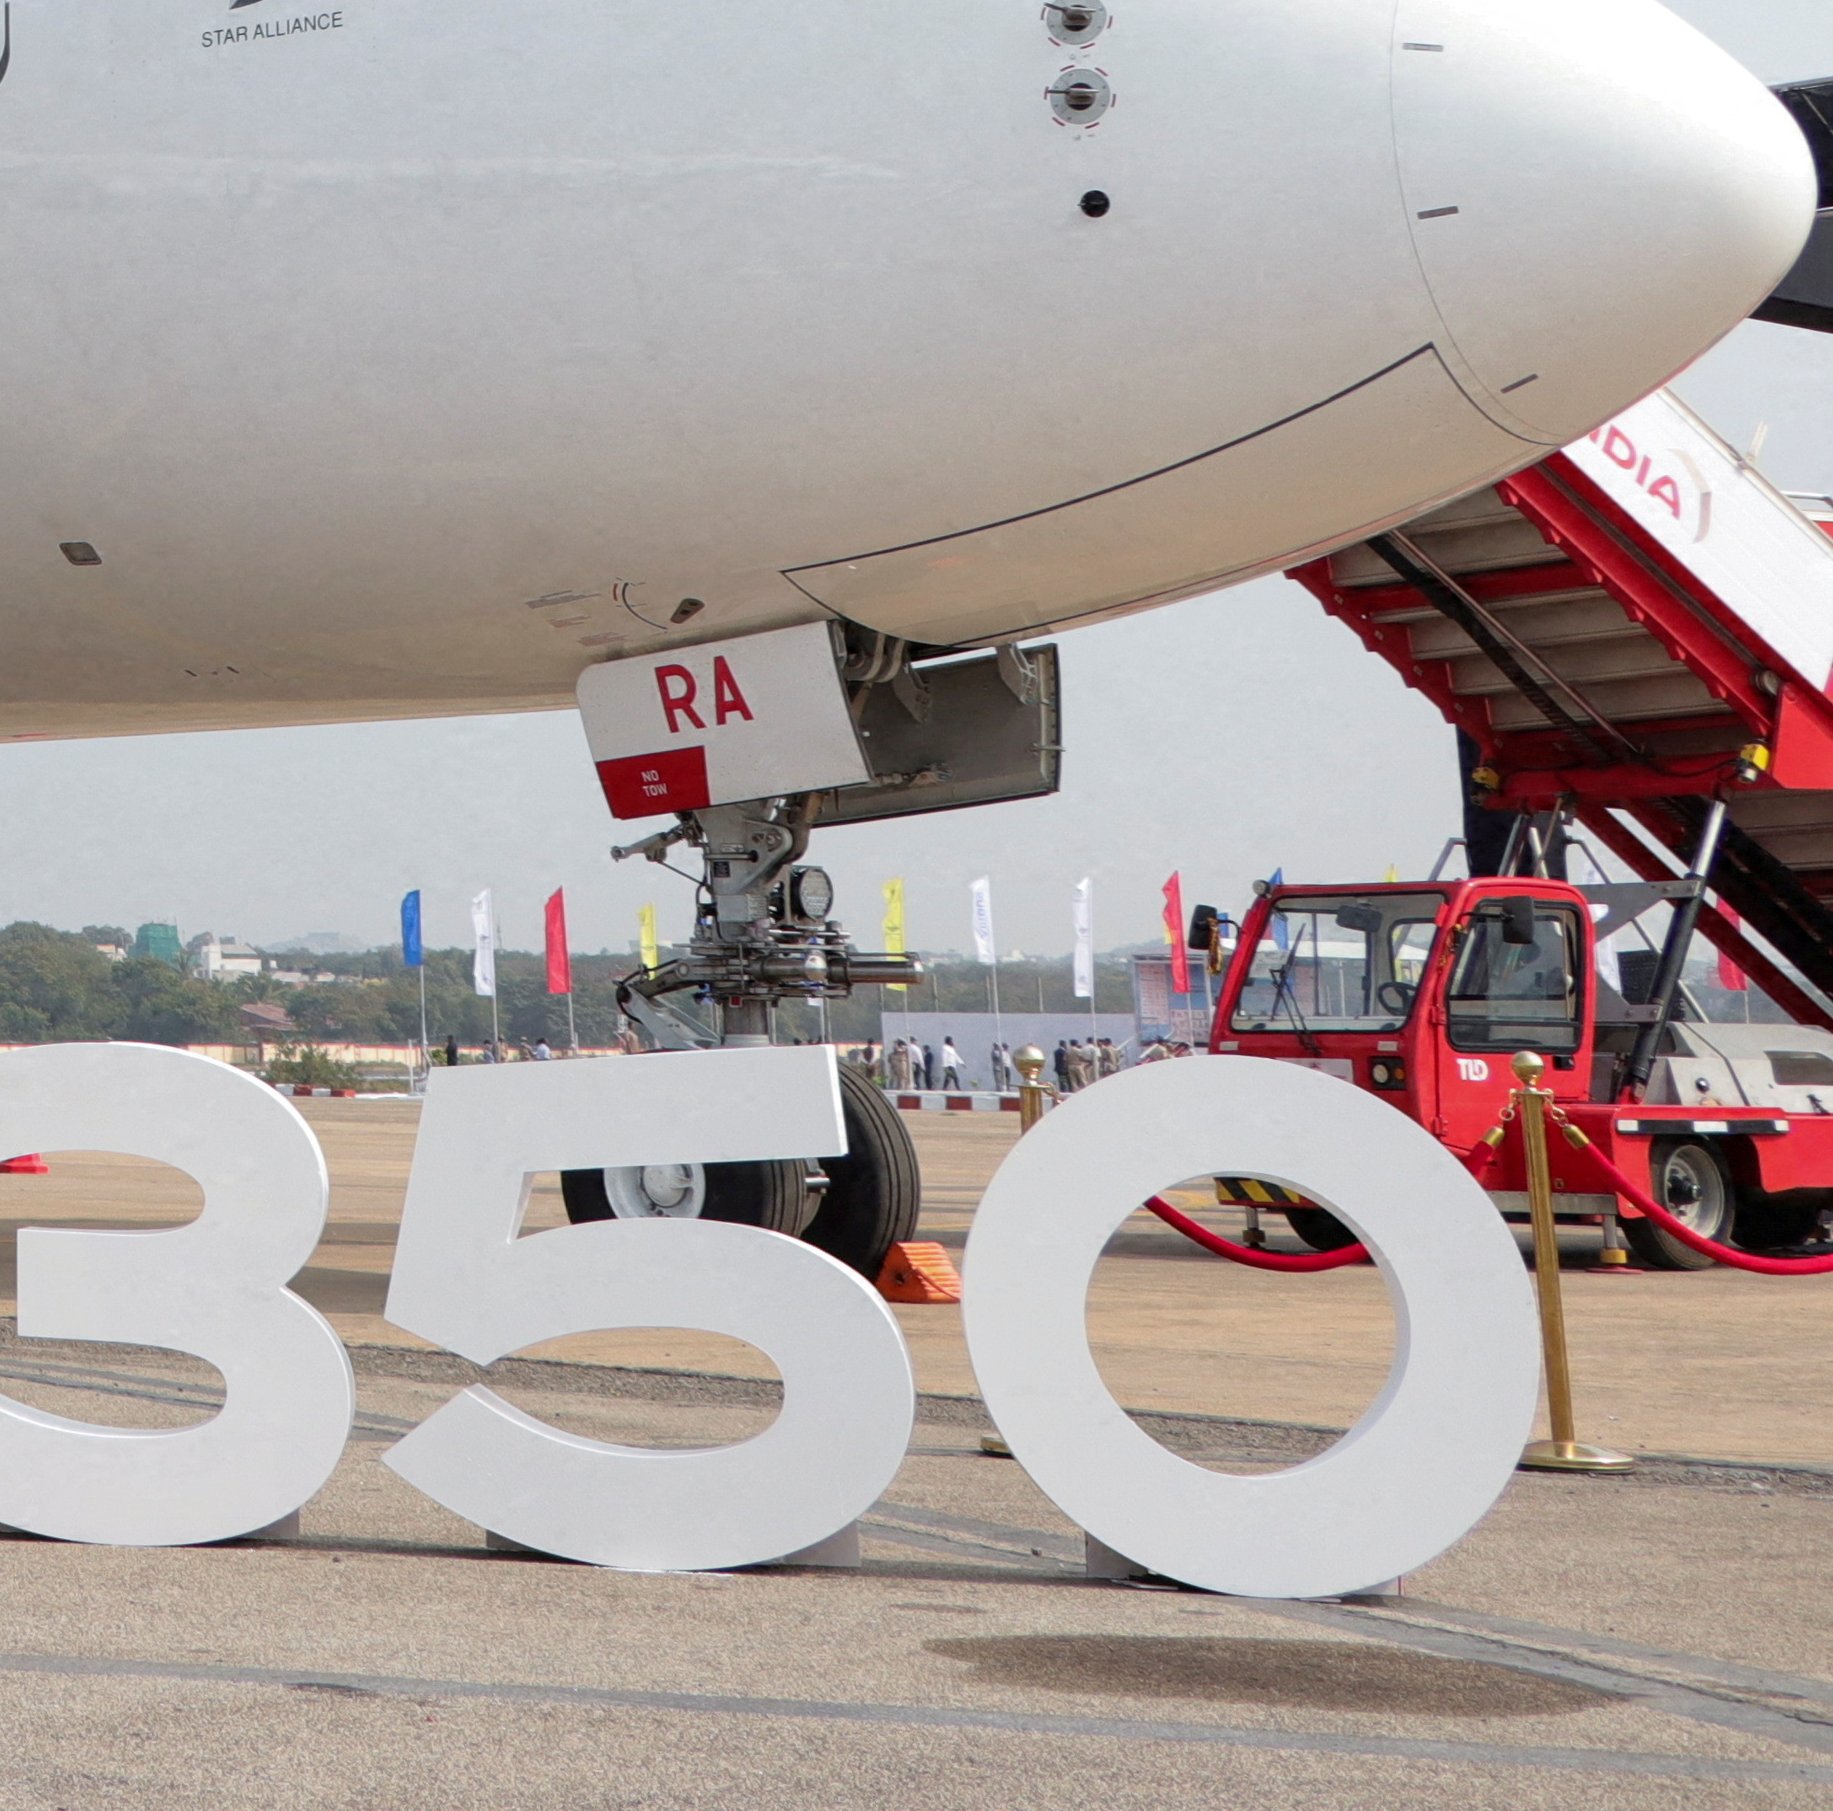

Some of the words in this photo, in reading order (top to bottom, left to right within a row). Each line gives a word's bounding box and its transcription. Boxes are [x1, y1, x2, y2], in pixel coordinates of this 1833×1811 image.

[201, 26, 248, 48] STAR
[252, 11, 344, 40] ALLIANCE
[654, 655, 754, 733] RA
[641, 770, 660, 782] NO
[642, 783, 668, 797] TOW
